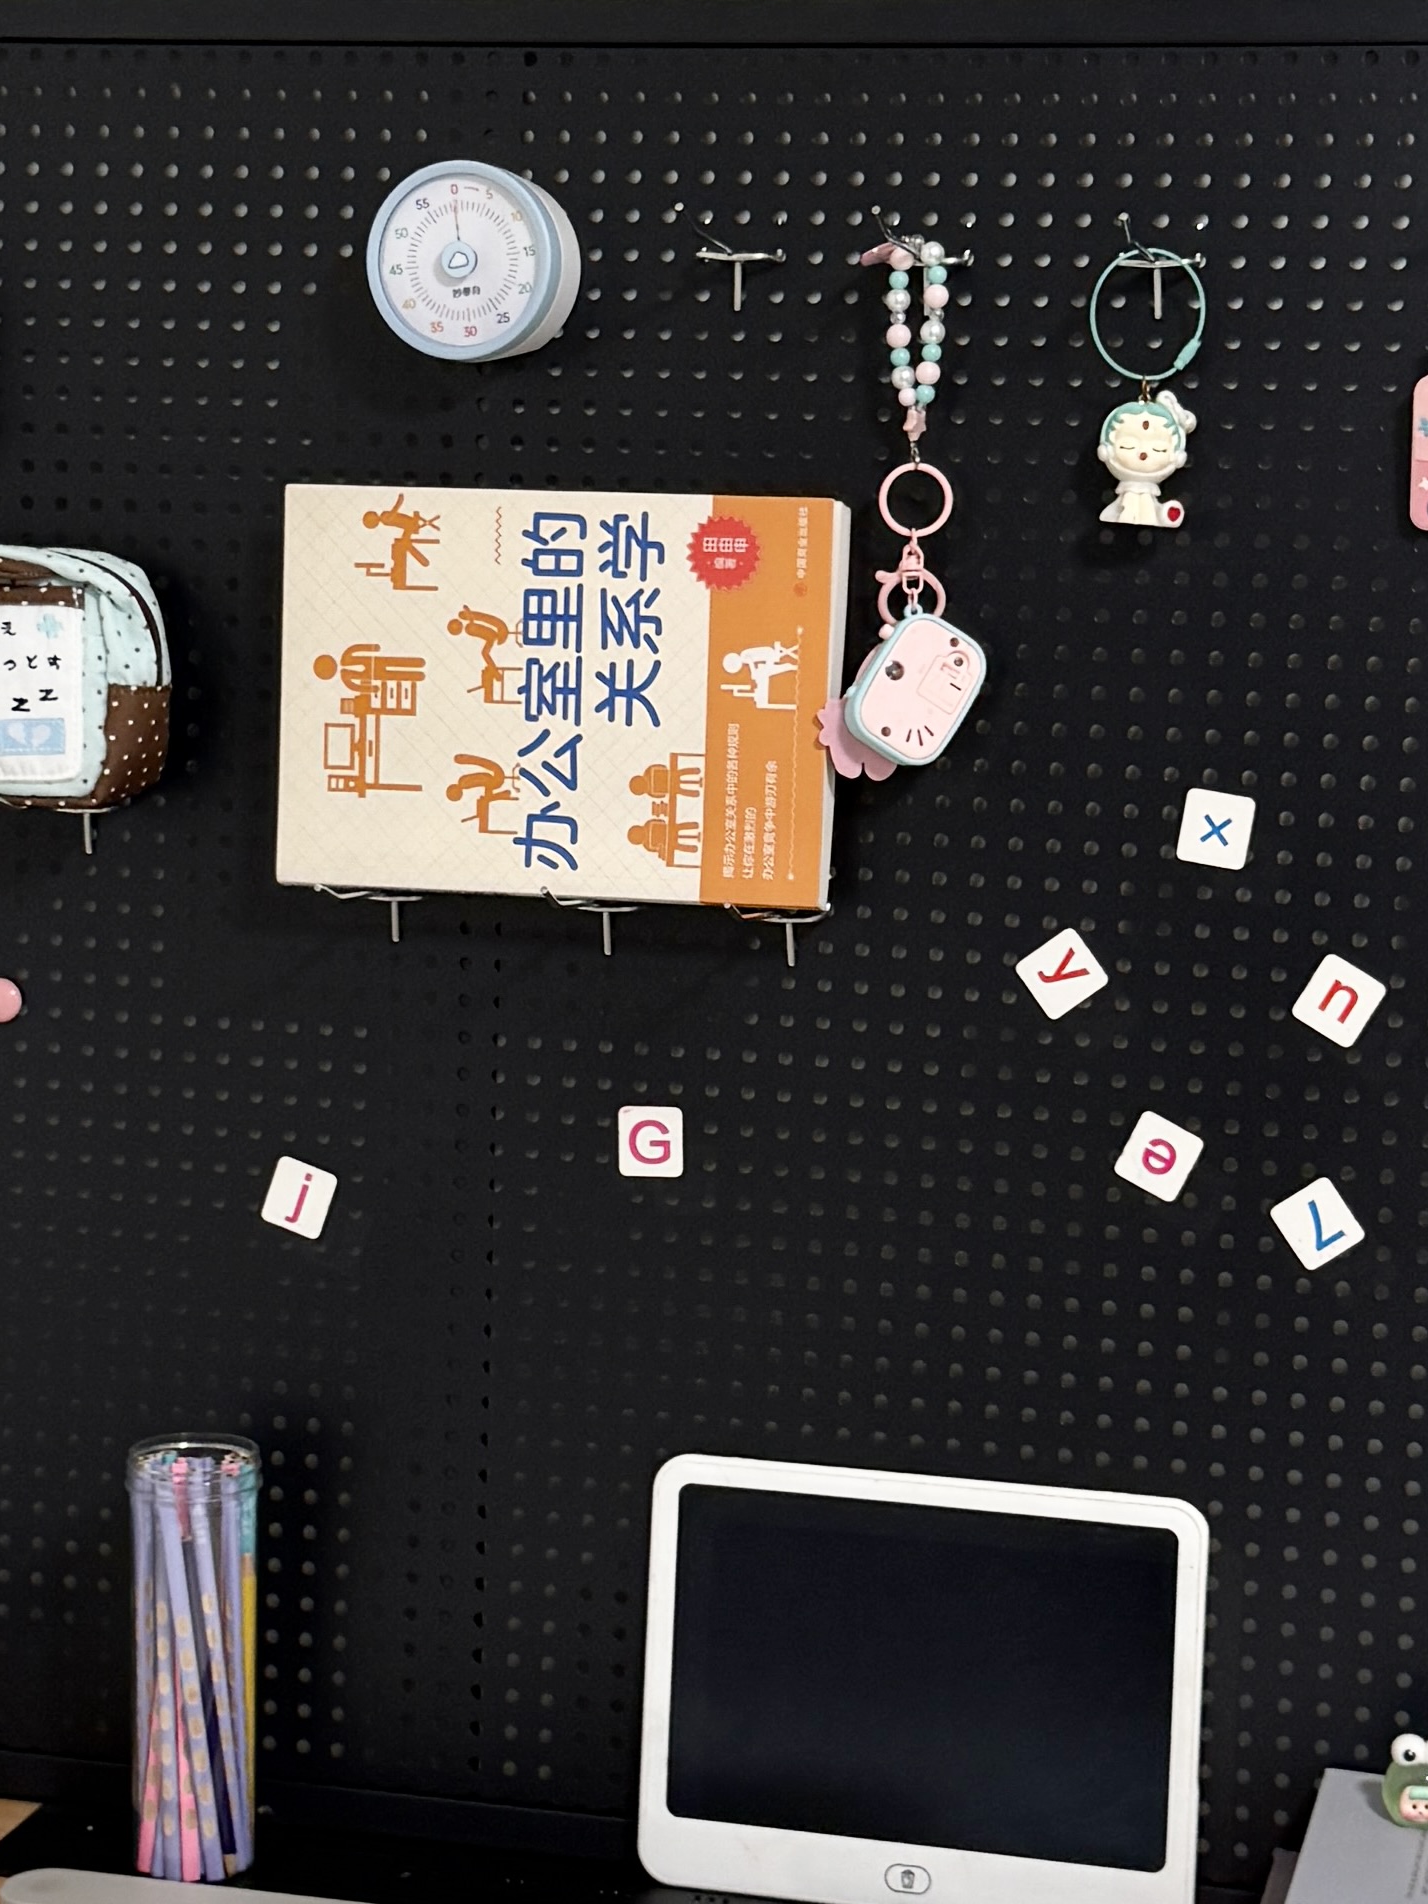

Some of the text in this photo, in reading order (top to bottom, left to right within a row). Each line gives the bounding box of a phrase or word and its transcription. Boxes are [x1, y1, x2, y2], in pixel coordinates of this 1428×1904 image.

[450, 184, 459, 195] 0
[486, 188, 494, 200] 5
[415, 198, 430, 210] 55
[511, 211, 523, 222] 10
[394, 227, 409, 240] 50
[523, 246, 536, 257] 15
[389, 264, 404, 276] 45
[518, 282, 533, 295] 20
[402, 299, 417, 311] 40
[496, 312, 511, 325] 25
[430, 322, 444, 333] 35
[463, 326, 478, 337] 30
[595, 511, 664, 727] 关系学
[513, 511, 587, 871] 办公室里的
[628, 1119, 671, 1165] G
[285, 1174, 313, 1223] j
